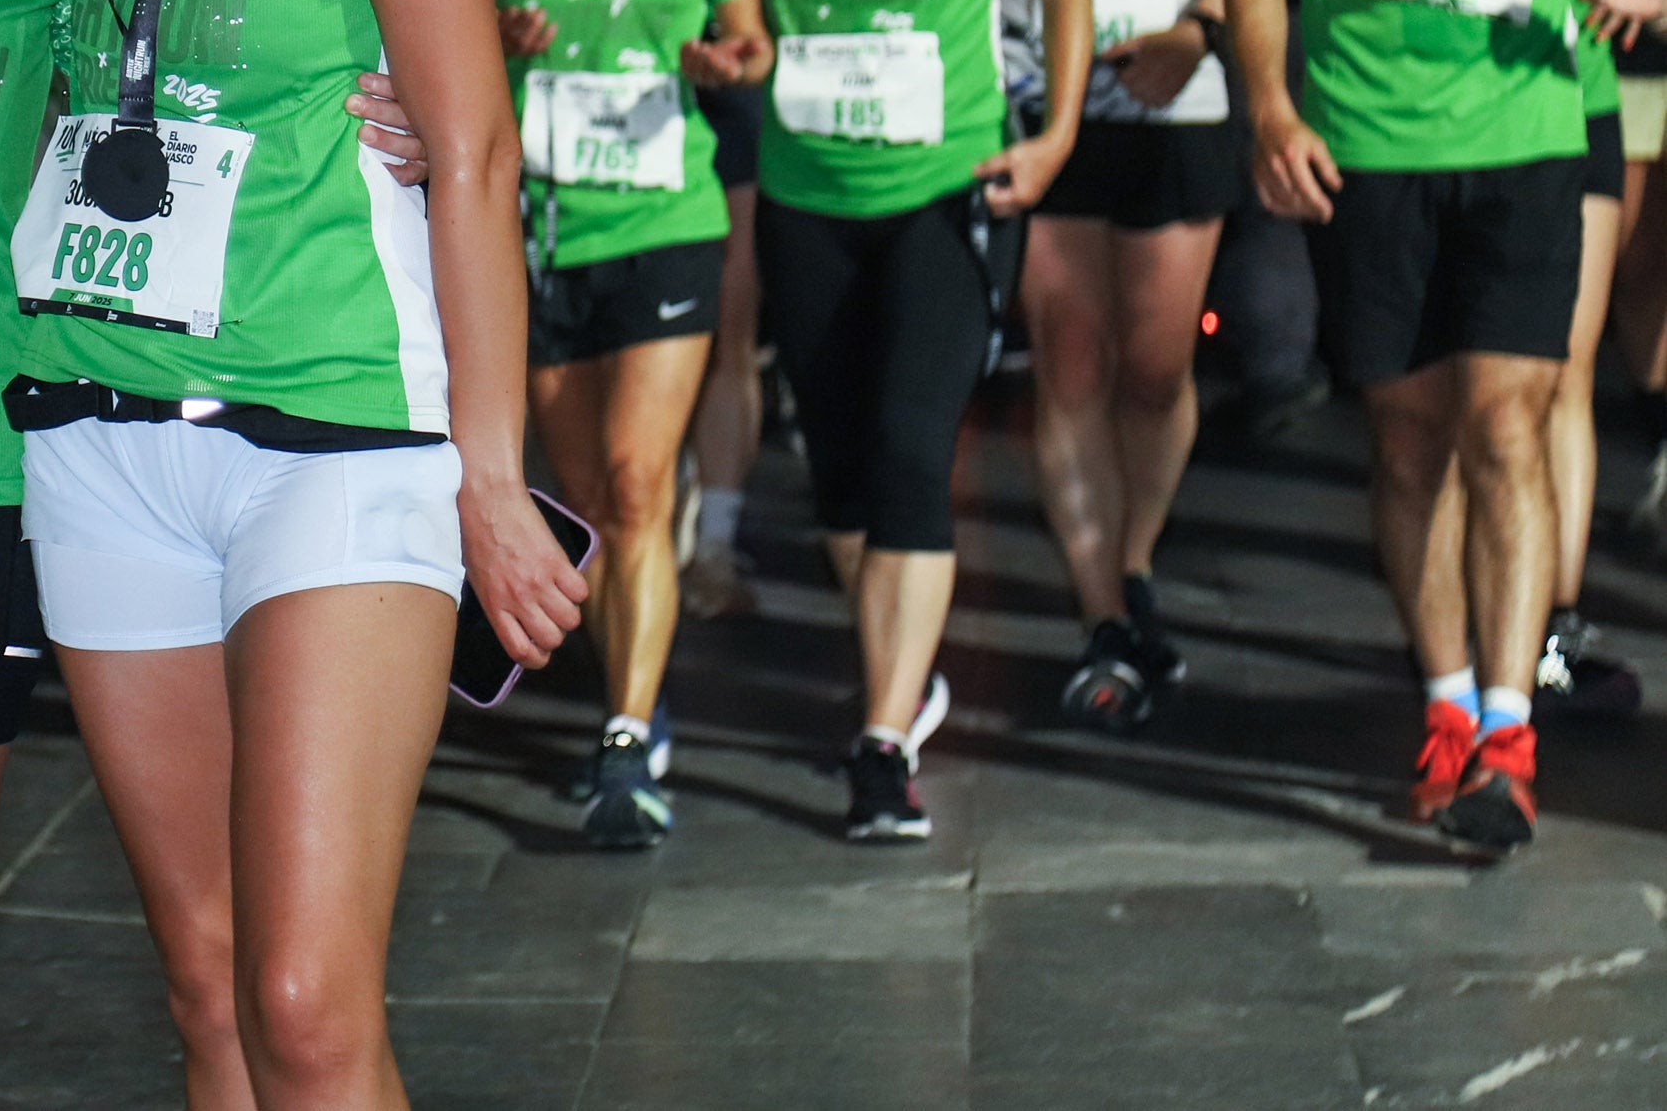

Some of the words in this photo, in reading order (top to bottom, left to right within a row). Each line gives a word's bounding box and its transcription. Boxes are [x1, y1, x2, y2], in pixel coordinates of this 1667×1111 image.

[163, 74, 221, 111] 2025
[169, 131, 179, 141] EL
[167, 141, 197, 154] DIARIO
[165, 152, 194, 165] VASCO
[216, 149, 234, 178] 4
[51, 222, 153, 292] F828
[73, 293, 91, 303] JUN
[91, 295, 113, 306] 2025
